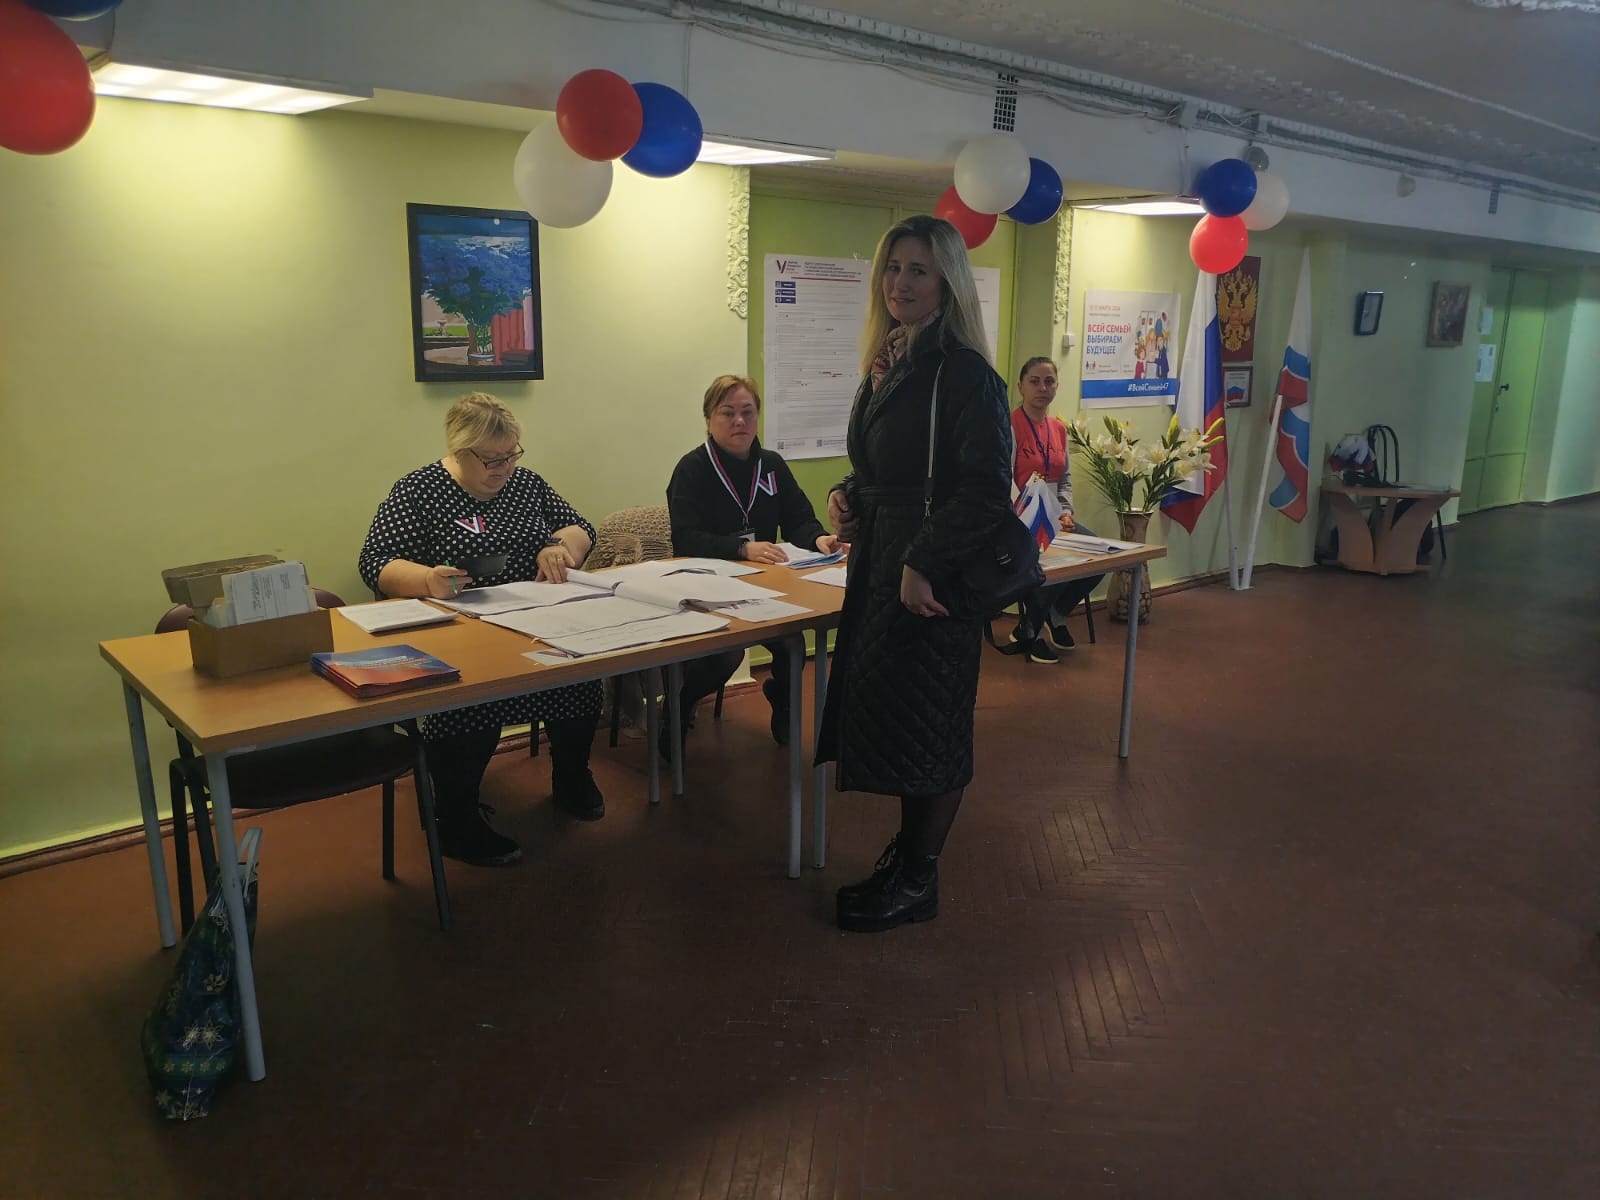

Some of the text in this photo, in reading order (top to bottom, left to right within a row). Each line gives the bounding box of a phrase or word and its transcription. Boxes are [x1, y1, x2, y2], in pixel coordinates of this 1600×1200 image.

[1087, 323, 1131, 333] ВСЕЙ СЕМЬЕЙ
[1087, 335, 1122, 344] ВЫБИРАЕМ
[1086, 346, 1116, 355] БУДУЩЕЕ
